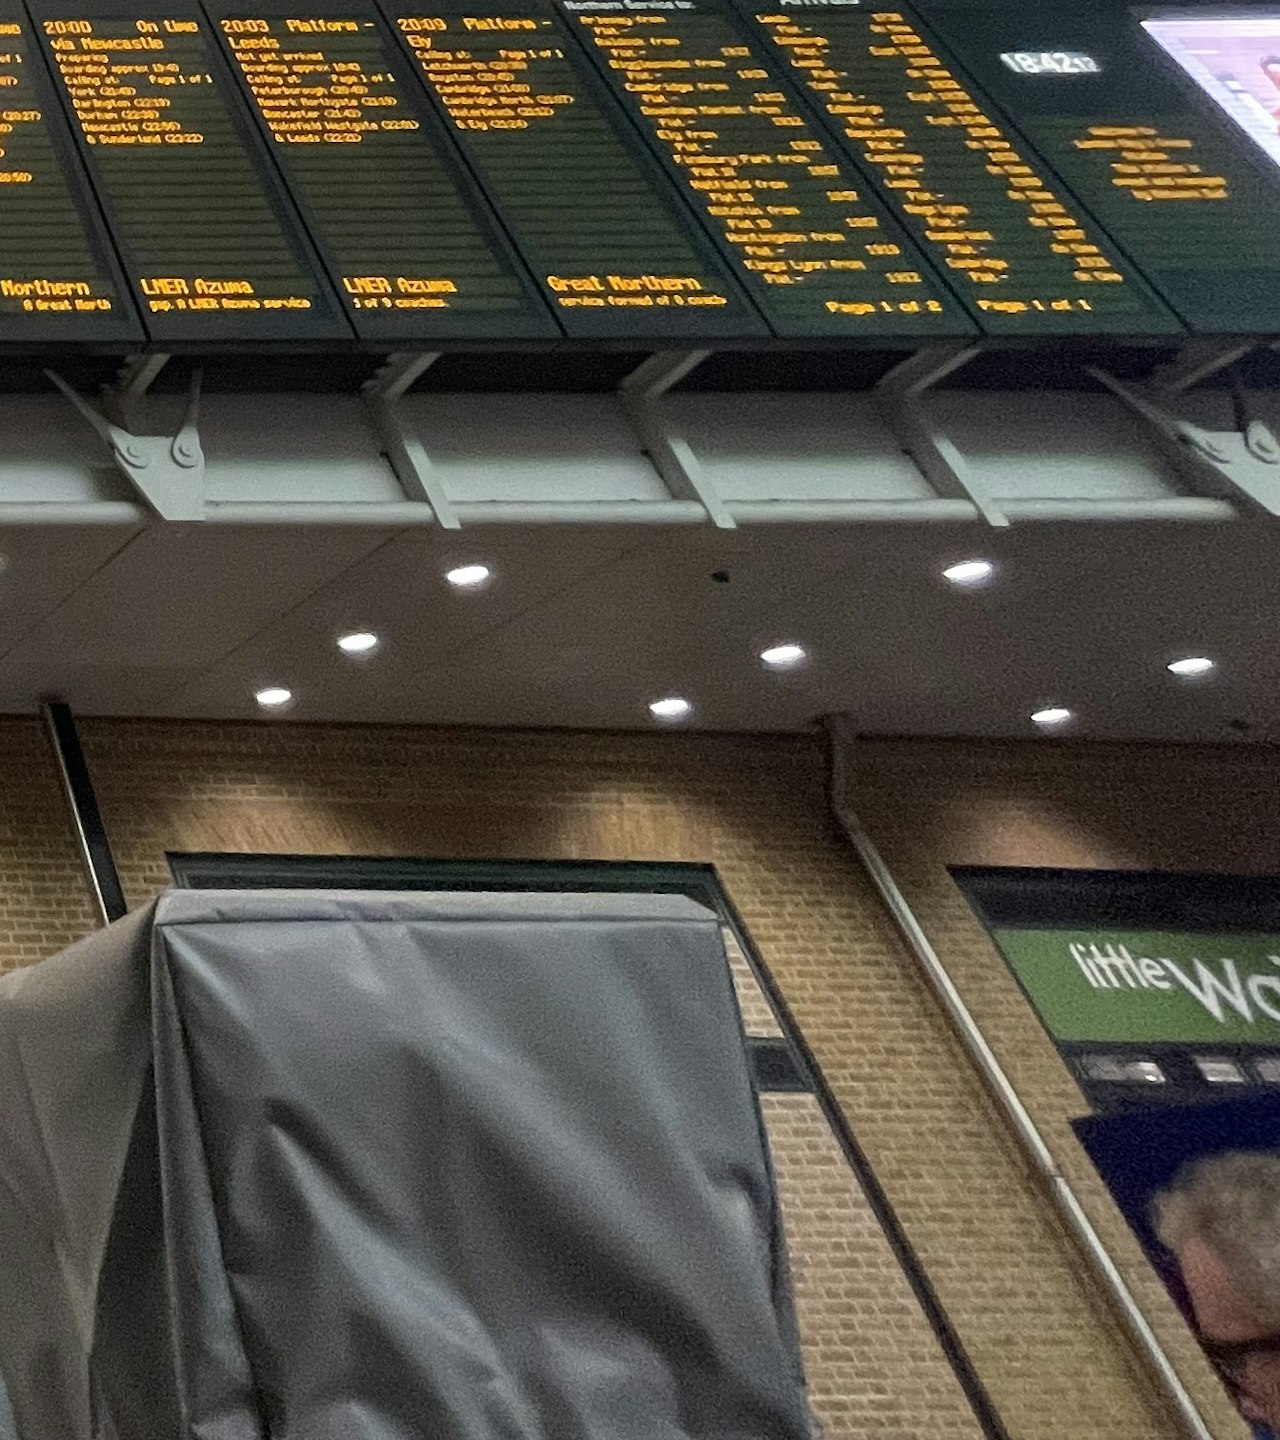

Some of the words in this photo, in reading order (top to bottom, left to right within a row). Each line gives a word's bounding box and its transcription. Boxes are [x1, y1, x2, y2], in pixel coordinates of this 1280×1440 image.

[44, 21, 92, 34] 20:00
[136, 20, 158, 32] On
[164, 20, 198, 32] time
[221, 20, 269, 32] 20:03
[286, 20, 358, 32] Platform
[397, 19, 446, 30] 20:09
[463, 18, 536, 30] Platform
[50, 38, 75, 50] via
[81, 37, 164, 50] Newcastle
[228, 37, 279, 49] Leeds
[407, 35, 431, 48] Ely
[0, 280, 90, 296] Northern
[141, 279, 189, 294] LNER
[195, 279, 254, 294] Azuma
[343, 277, 392, 293] LNER
[397, 277, 457, 292] Azuma
[547, 276, 605, 291] Great
[604, 276, 701, 290] Northern
[1069, 942, 1172, 990] little
[1168, 957, 1280, 1024] Wa
